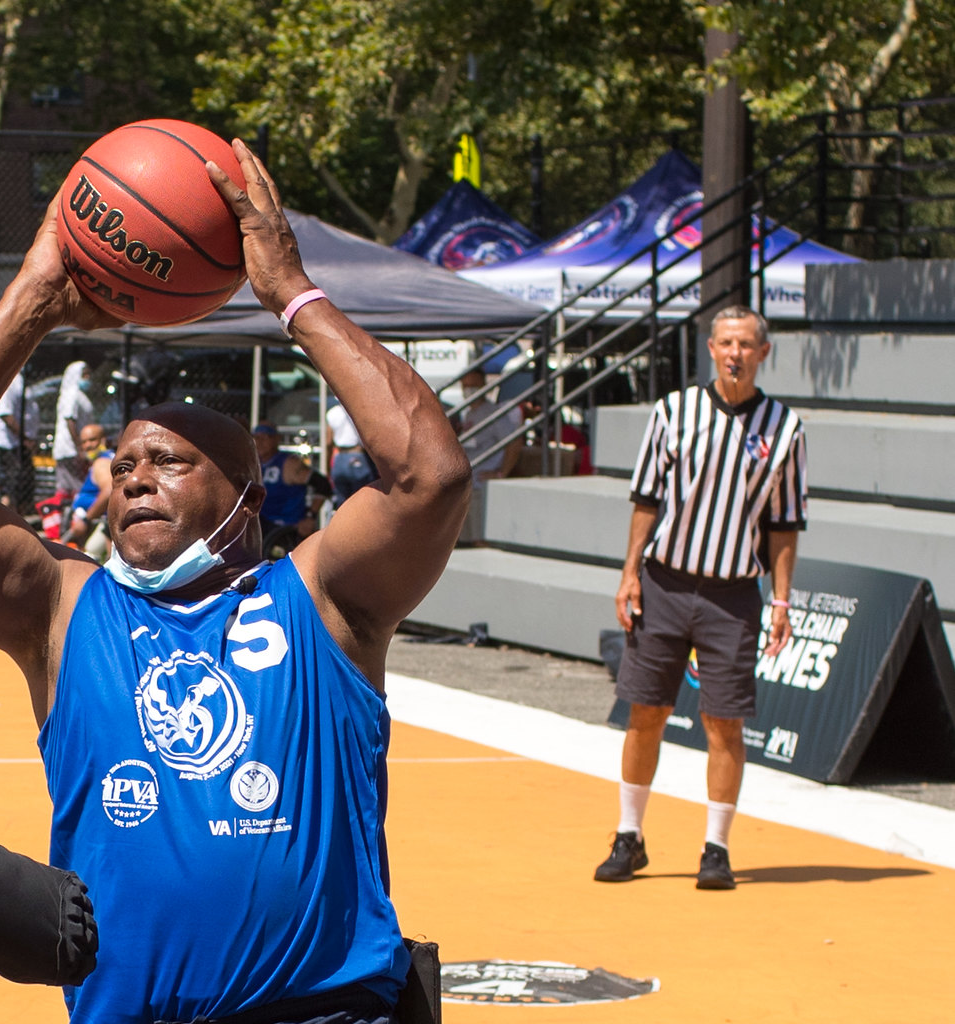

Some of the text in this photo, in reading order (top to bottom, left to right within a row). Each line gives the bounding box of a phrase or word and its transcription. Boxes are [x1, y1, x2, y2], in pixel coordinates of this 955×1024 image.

[69, 174, 174, 282] Wilson
[61, 243, 135, 313] NCAA
[810, 592, 859, 617] VETERANS
[226, 592, 290, 673] 5
[761, 604, 850, 645] WELCHAIR
[245, 713, 255, 725] NY
[219, 757, 235, 772] 2021
[112, 777, 160, 805] PVA
[208, 819, 232, 836] VA
[252, 816, 287, 827] Deparent
